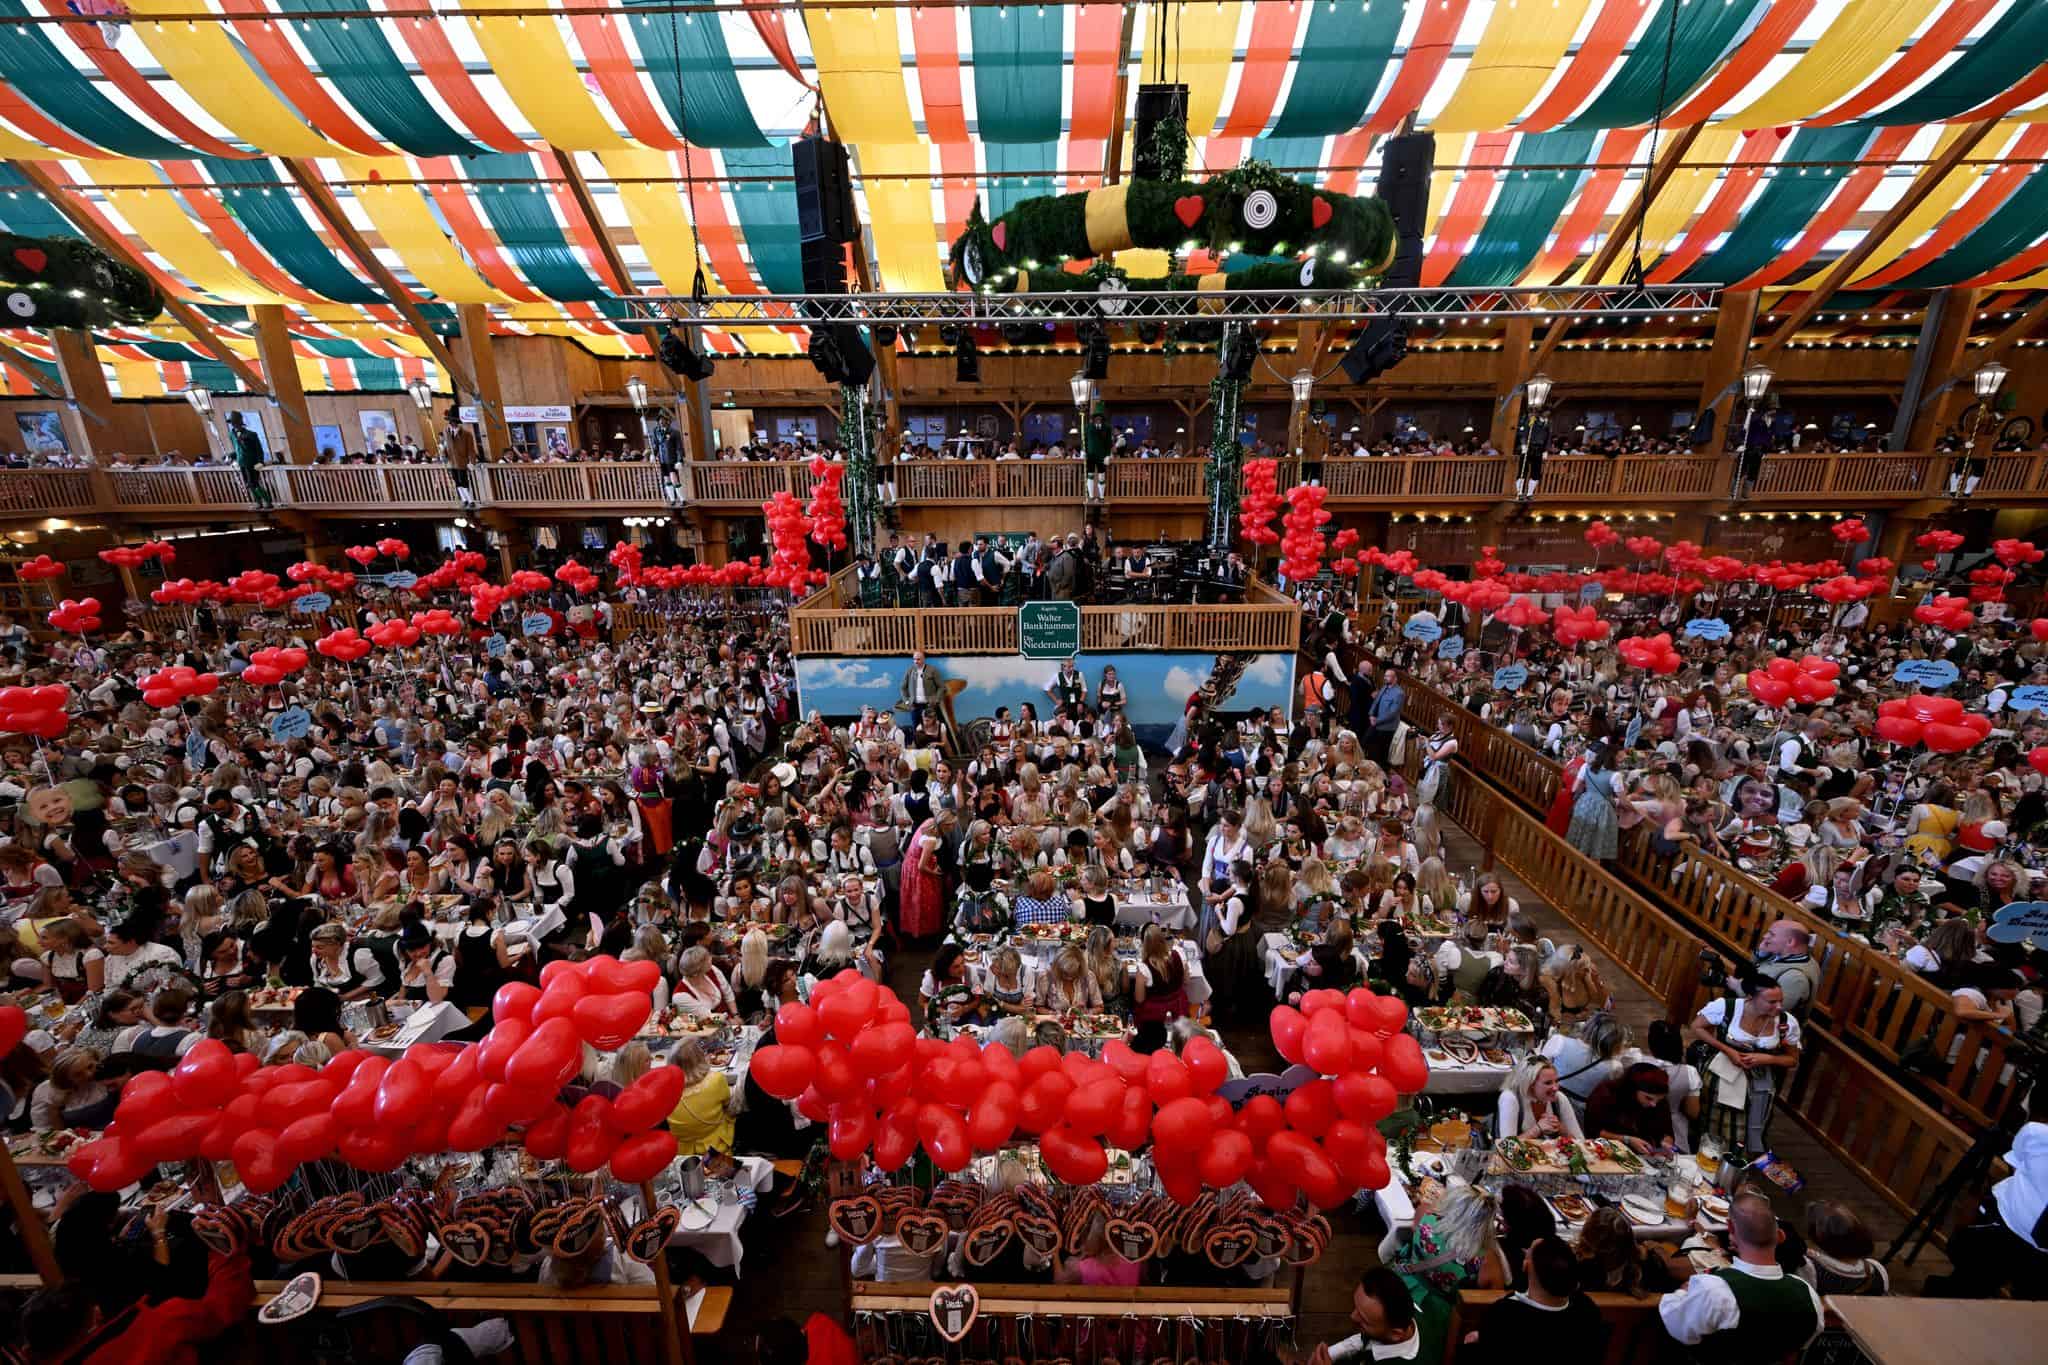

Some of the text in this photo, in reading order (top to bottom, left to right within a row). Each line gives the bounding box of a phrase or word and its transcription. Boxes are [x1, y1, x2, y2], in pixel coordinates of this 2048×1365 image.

[1037, 613, 1062, 622] Walter
[1023, 622, 1075, 630] Bankhammer
[1023, 640, 1075, 649] Niederalmer
